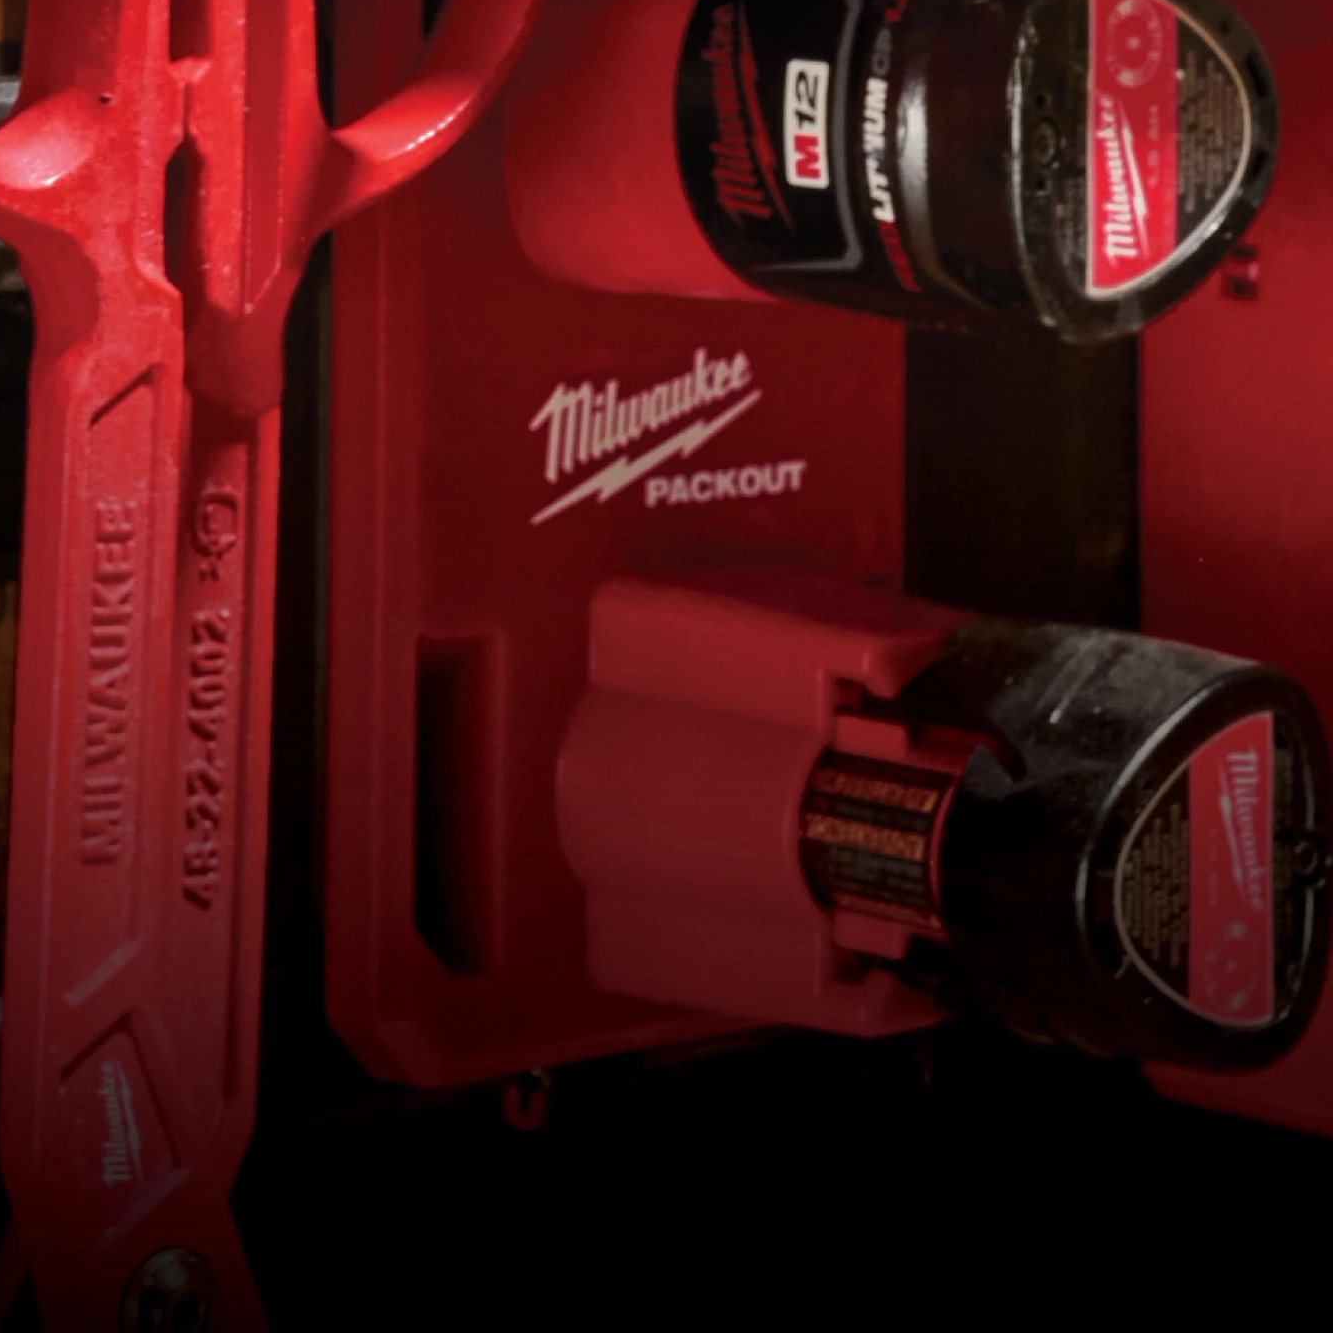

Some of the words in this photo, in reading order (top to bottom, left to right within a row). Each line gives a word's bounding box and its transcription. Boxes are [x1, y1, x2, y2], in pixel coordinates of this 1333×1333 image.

[700, 2, 772, 226] Milwaukee
[791, 69, 823, 179] M12
[531, 348, 752, 482] Milwaukee
[645, 460, 807, 507] PACKOUT
[81, 496, 136, 866] MILWAUKEE
